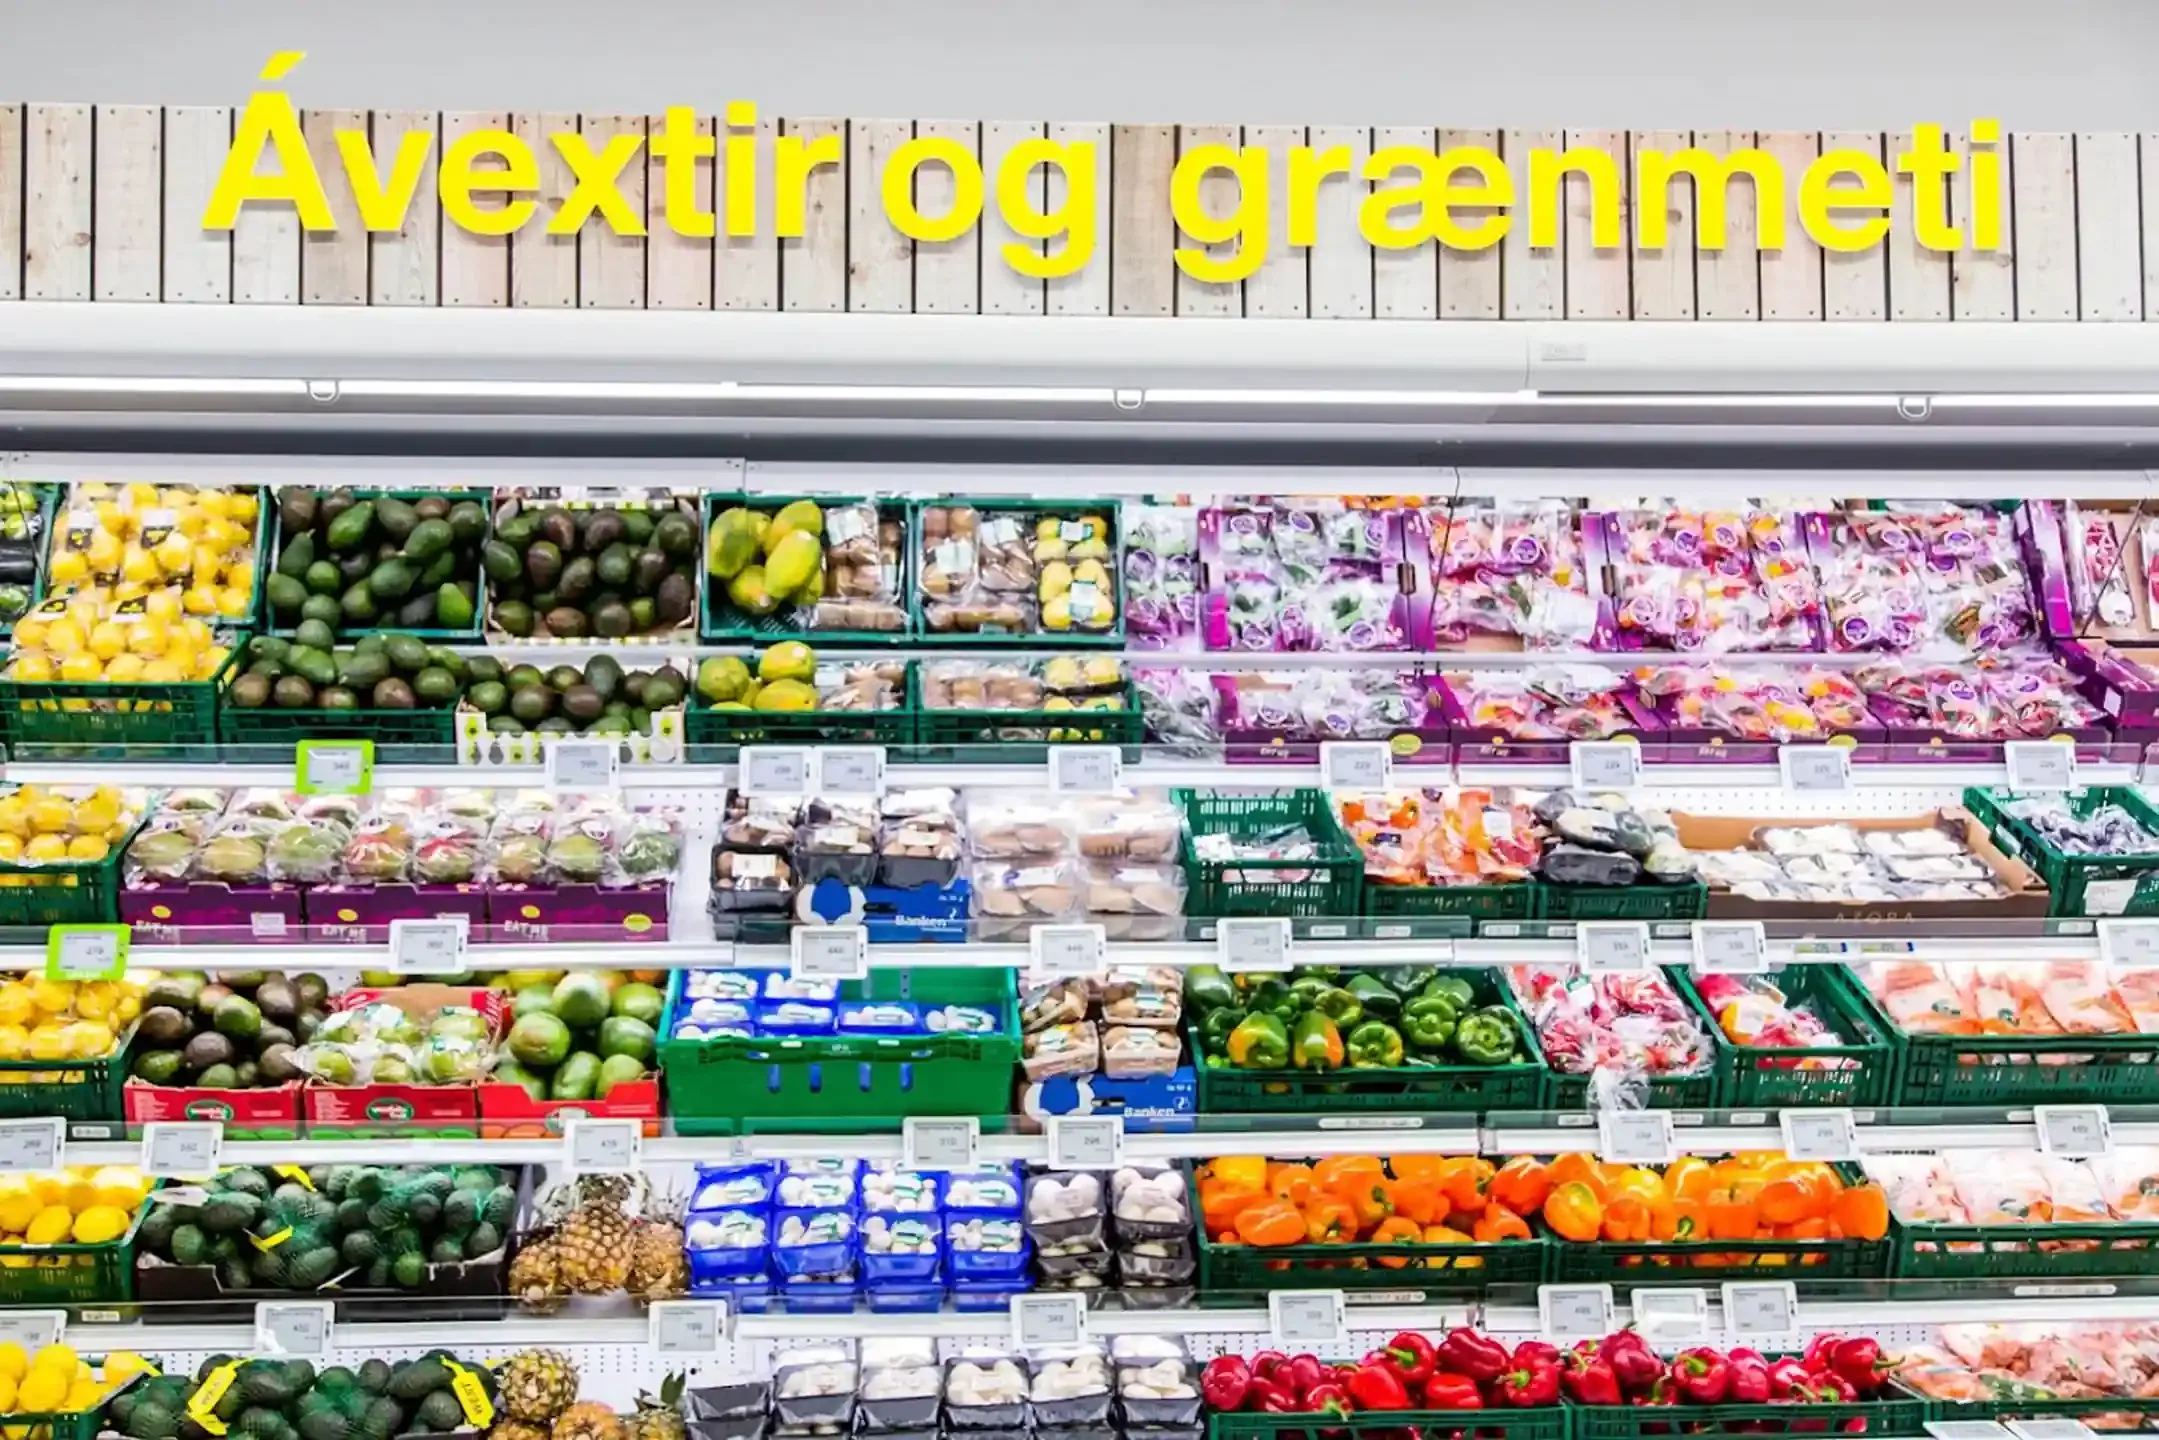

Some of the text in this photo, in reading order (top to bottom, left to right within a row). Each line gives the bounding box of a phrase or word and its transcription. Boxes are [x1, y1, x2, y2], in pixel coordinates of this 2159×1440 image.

[202, 51, 2001, 283] Ávextir og grænmeti
